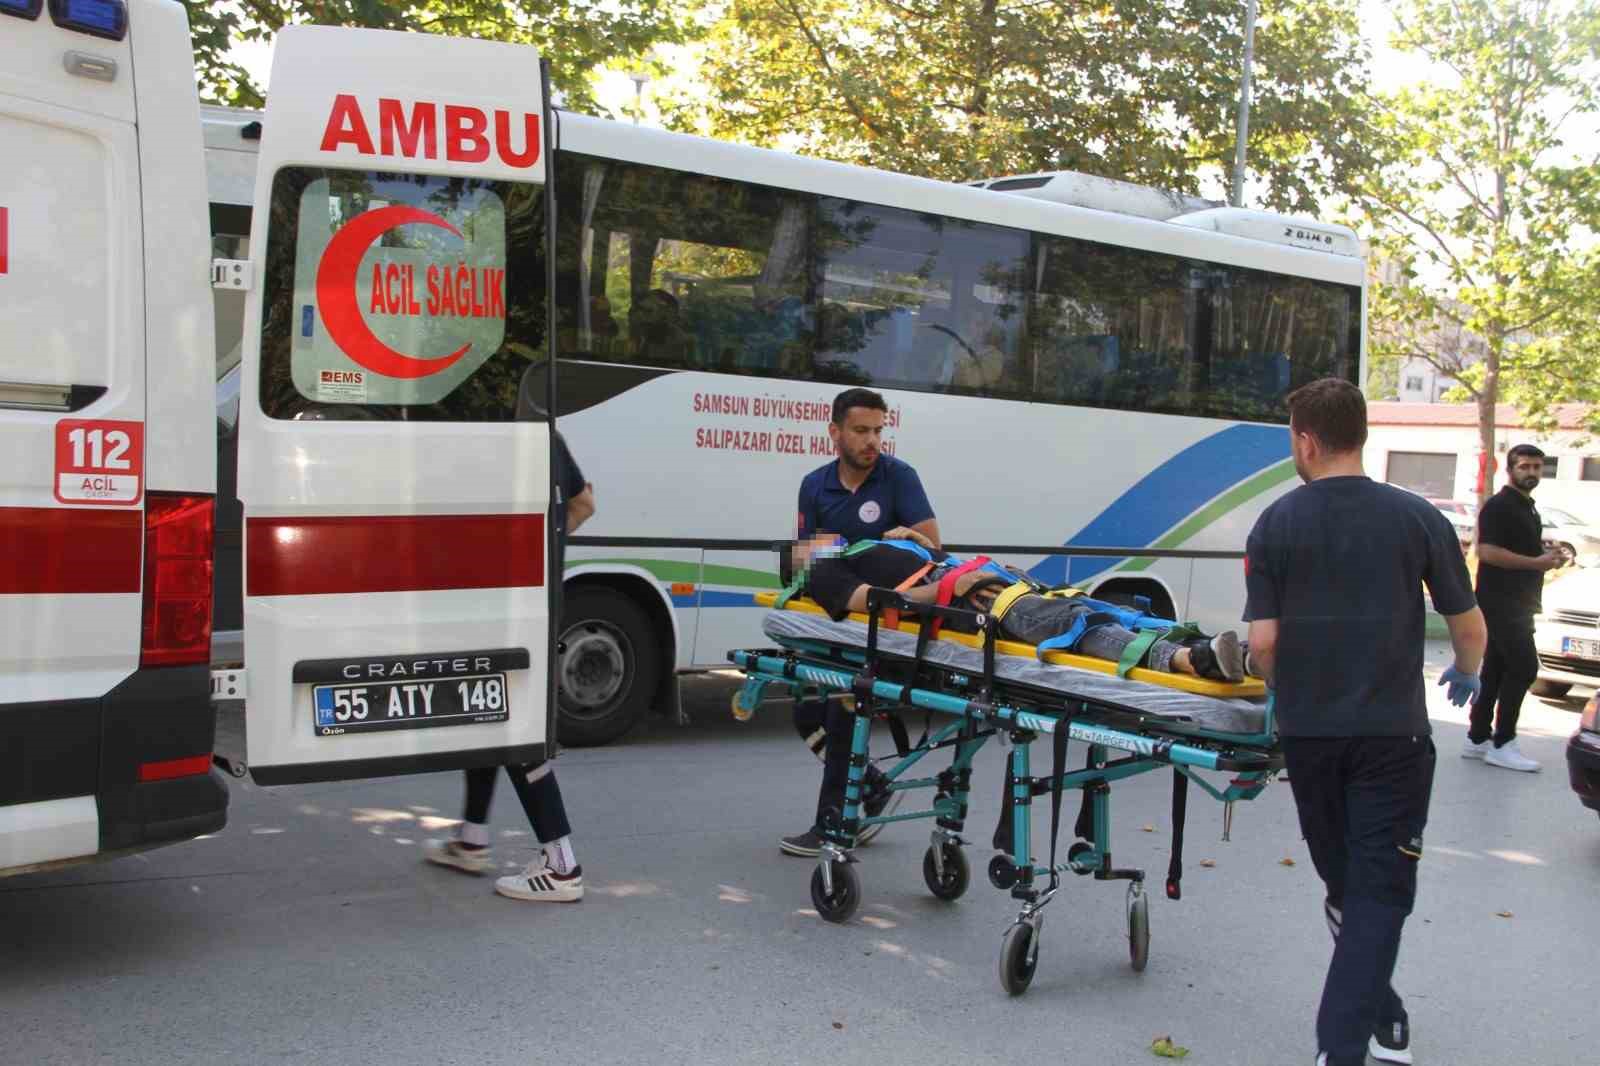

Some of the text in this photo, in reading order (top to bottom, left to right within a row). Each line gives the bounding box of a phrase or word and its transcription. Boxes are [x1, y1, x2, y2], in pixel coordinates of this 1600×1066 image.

[319, 93, 541, 169] AMBU
[426, 260, 506, 319] SAĞLIK
[333, 371, 363, 385] EMS
[693, 391, 832, 423] SAMSUN BÜYÜKŞEHİR
[68, 428, 131, 470] 112
[696, 427, 772, 453] SALIPAZARI
[776, 426, 806, 455] ÖZEL
[81, 475, 118, 491] ACİL
[343, 657, 491, 678] CRAFTER
[320, 679, 502, 721] TR 55 ATY 148
